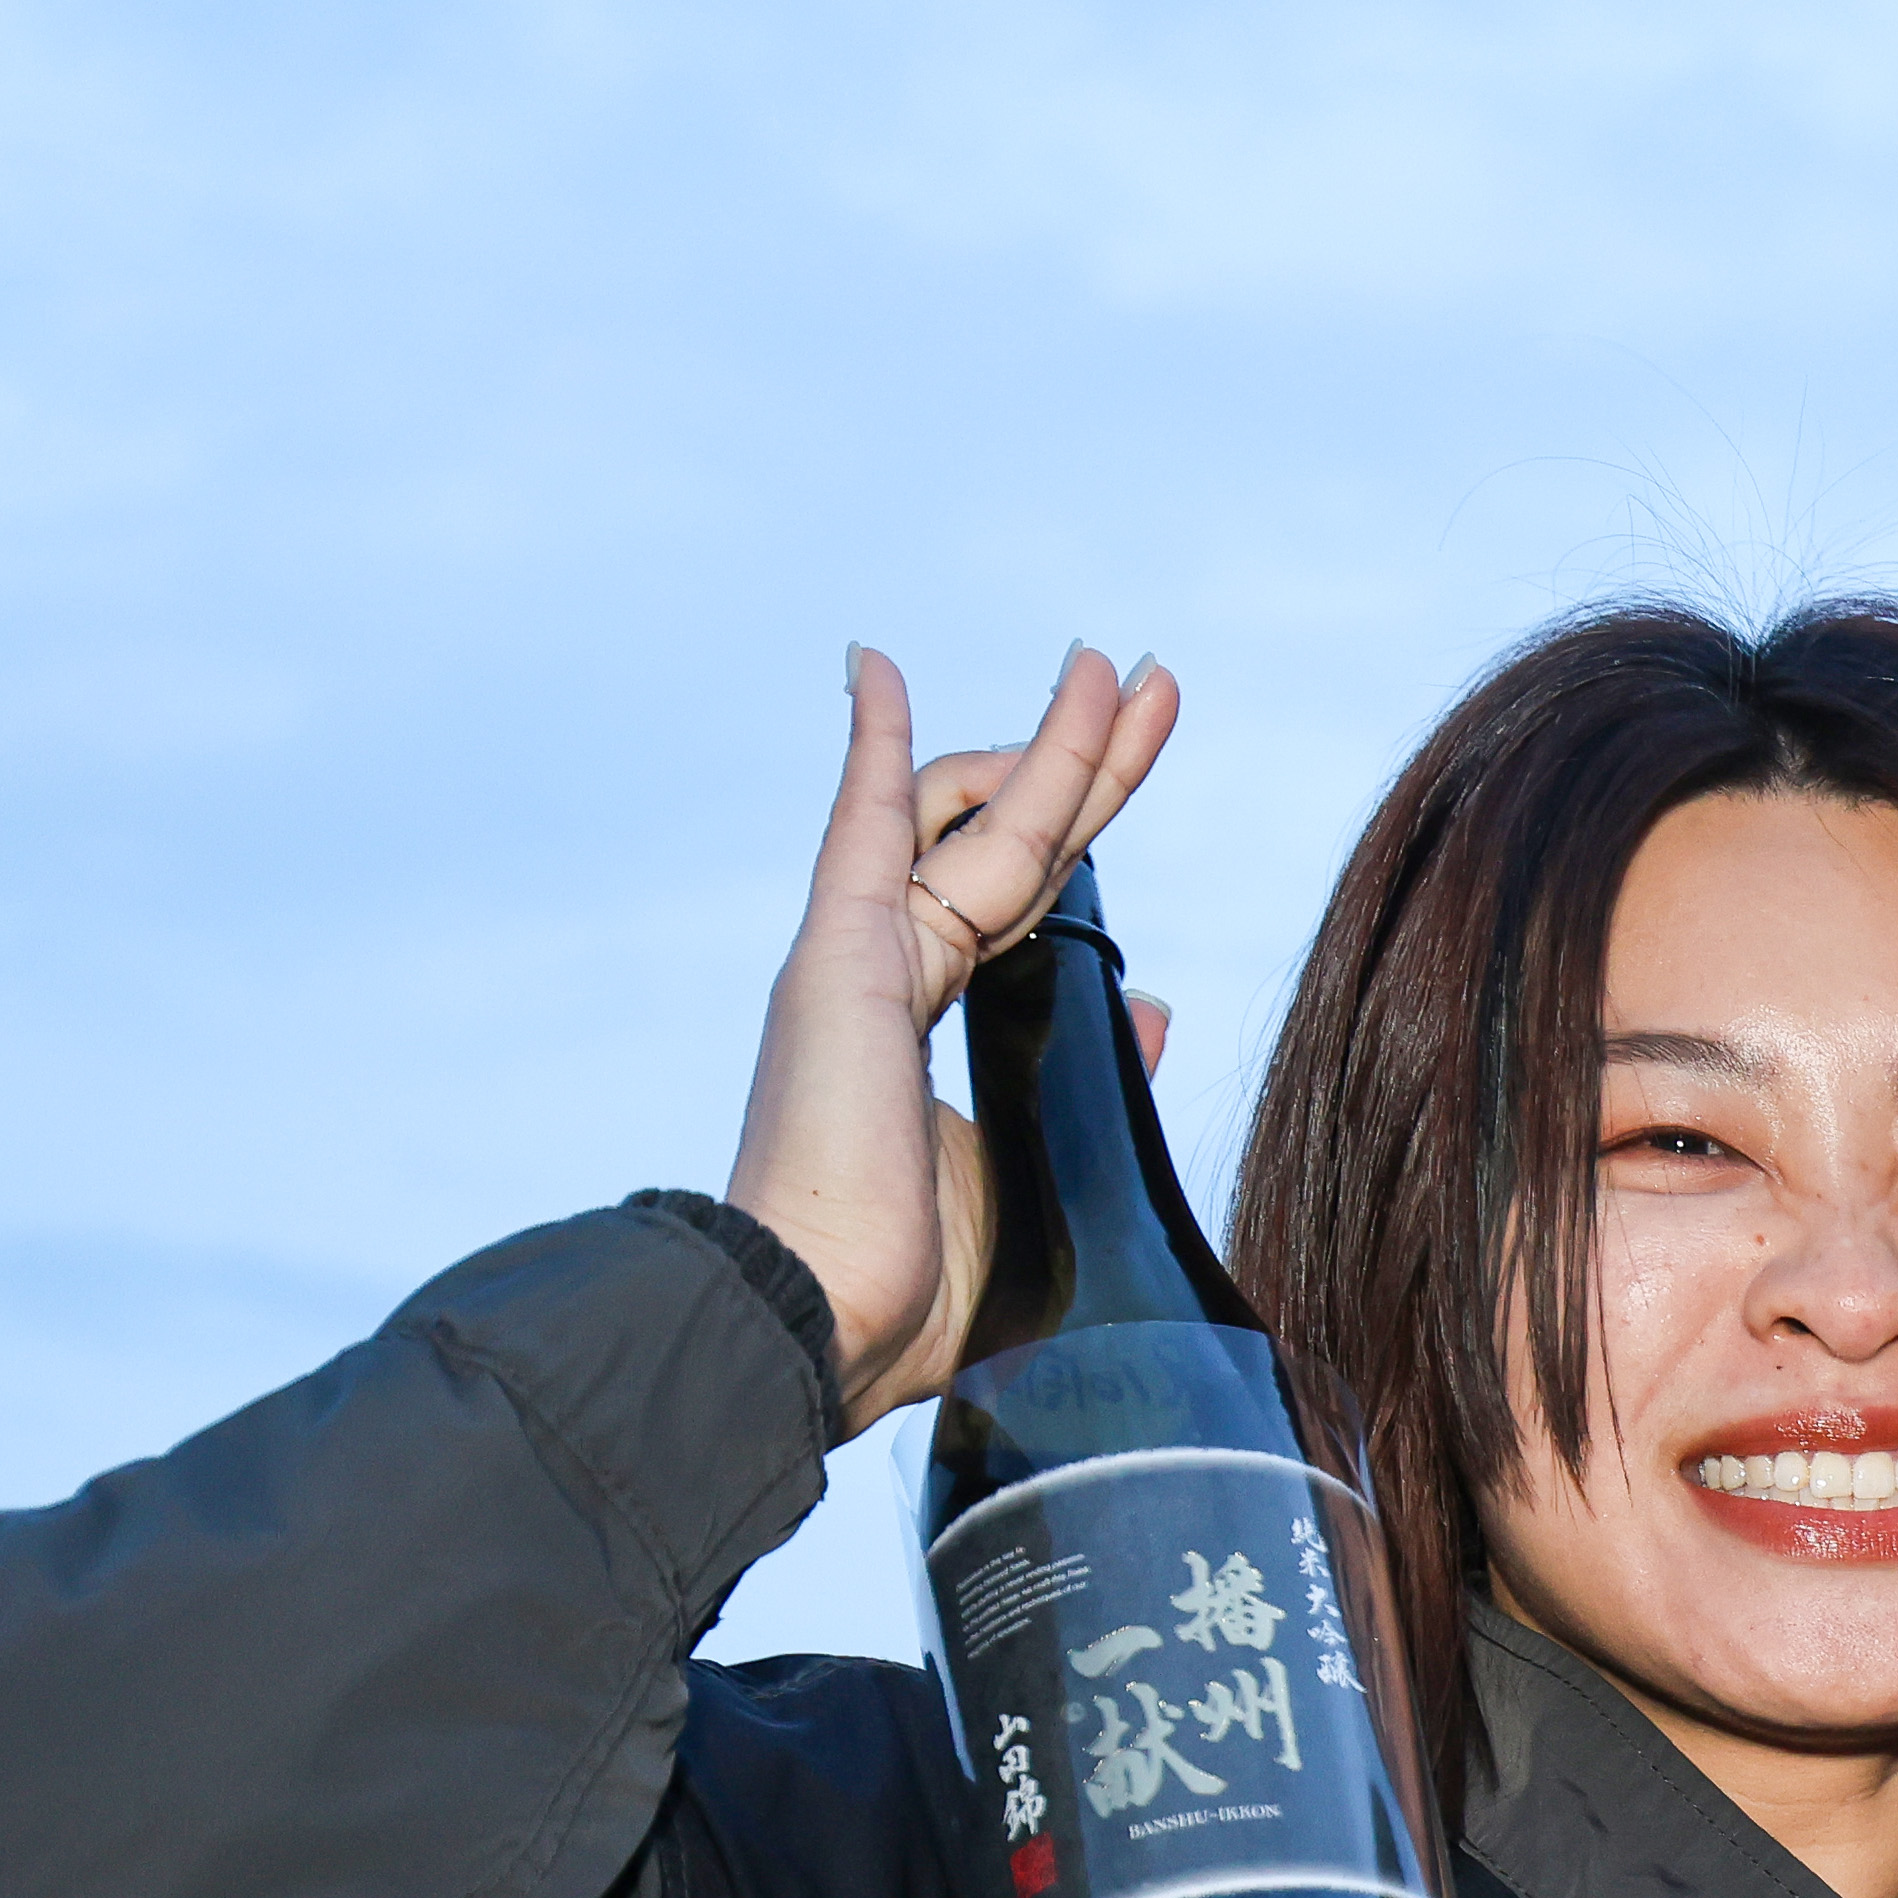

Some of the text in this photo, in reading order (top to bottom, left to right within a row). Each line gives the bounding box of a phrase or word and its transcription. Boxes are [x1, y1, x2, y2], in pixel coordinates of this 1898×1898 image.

[1069, 1623, 1228, 1819] 一献
[1171, 1551, 1303, 1772] 播州
[1128, 1804, 1283, 1840] BANSHU-IKKON
